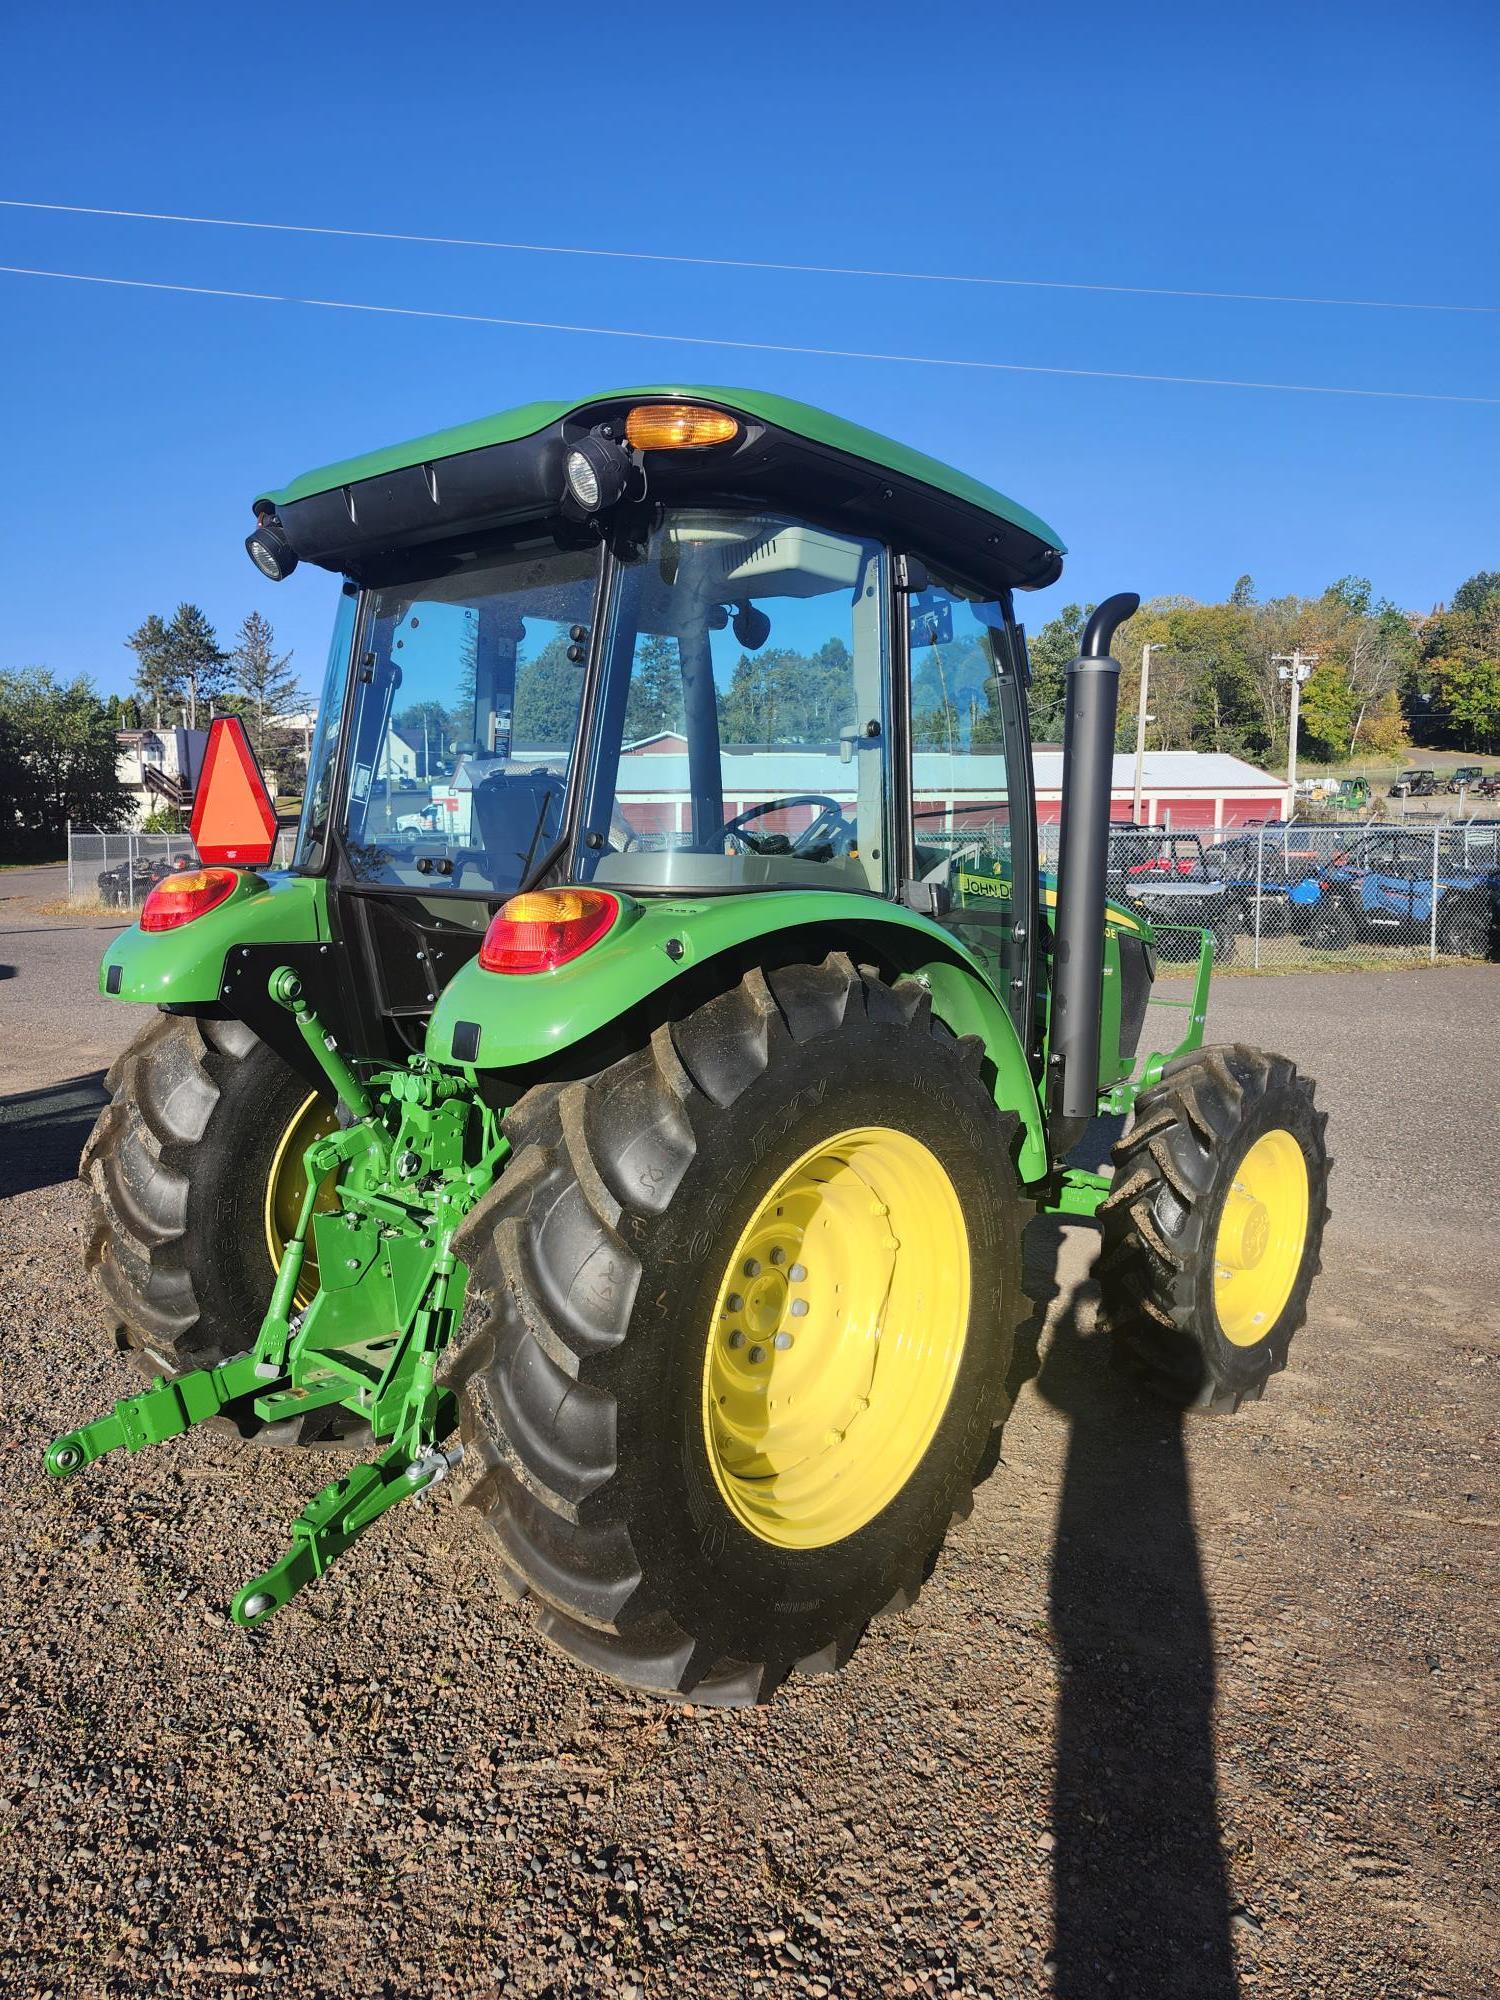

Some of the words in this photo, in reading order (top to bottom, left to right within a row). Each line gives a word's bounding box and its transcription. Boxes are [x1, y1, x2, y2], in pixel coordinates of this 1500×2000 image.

[963, 878, 998, 896] JOHN
[1000, 883, 1012, 899] D
[689, 1078, 831, 1265] GALAXY
